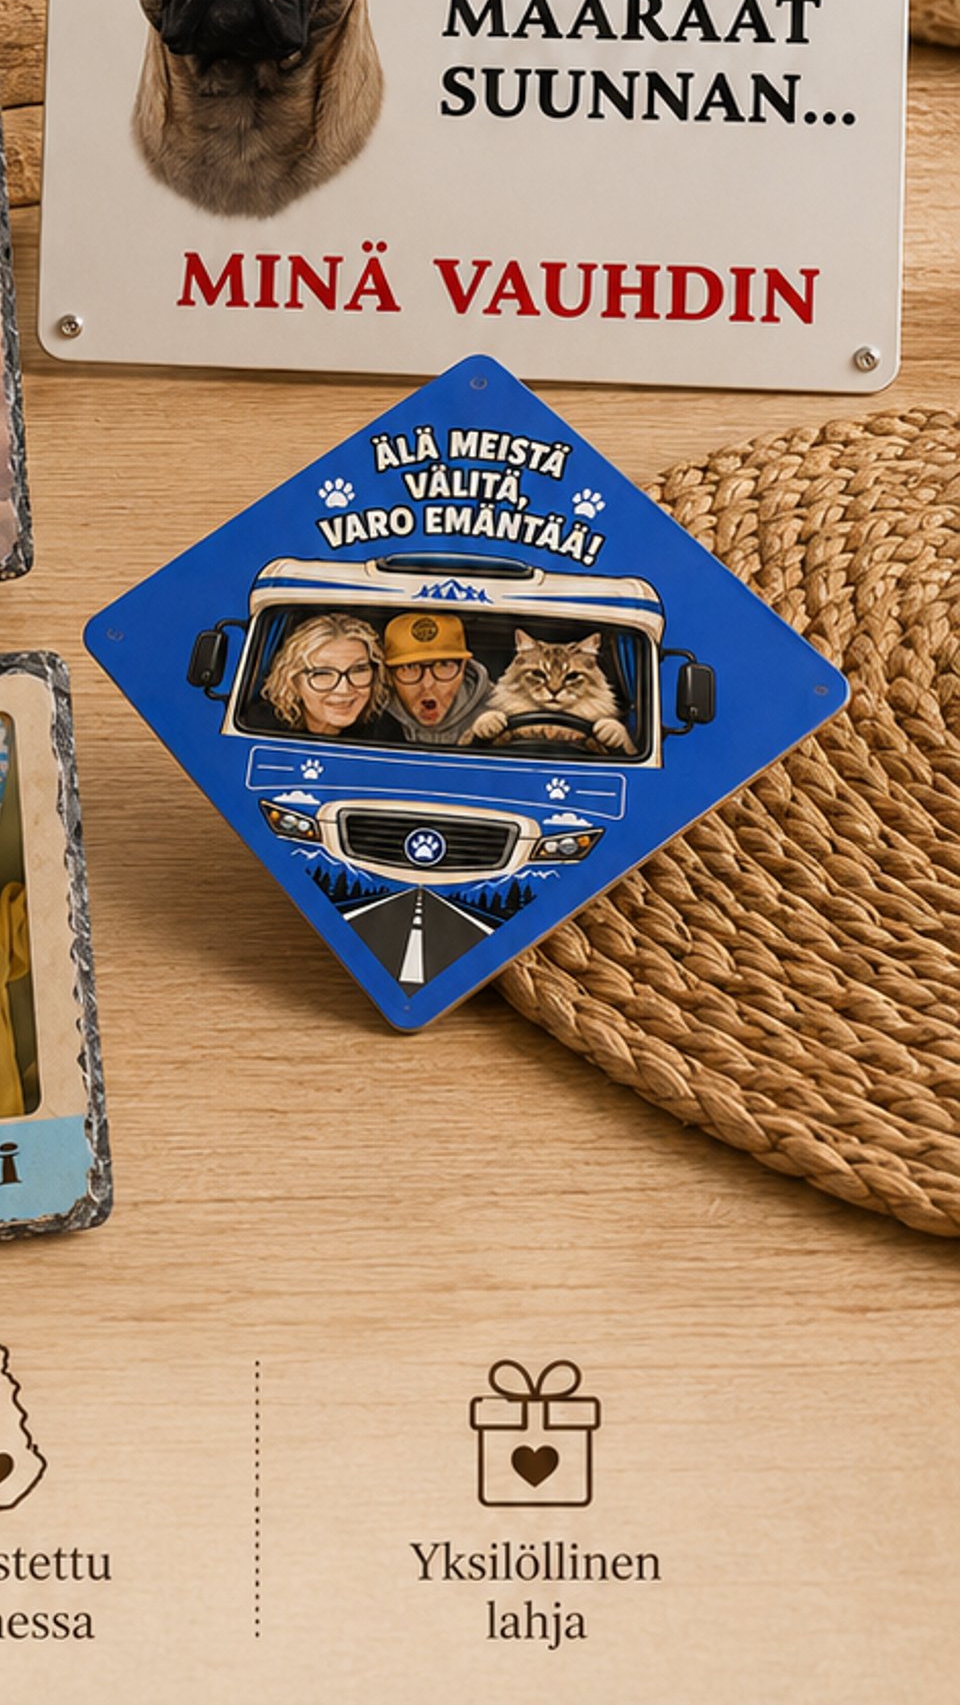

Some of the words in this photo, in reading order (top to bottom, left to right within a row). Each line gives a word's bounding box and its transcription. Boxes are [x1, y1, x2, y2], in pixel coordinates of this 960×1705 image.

[441, 67, 855, 125] SUUNNAN...
[177, 241, 401, 312] MINÄ
[433, 259, 819, 324] VAUHDIN
[371, 426, 440, 473] ÄLÄ
[448, 429, 571, 479] MEISTÄ
[404, 463, 529, 511] VÄLITÄ,
[318, 505, 415, 549] VARO
[424, 503, 605, 567] EMÄNTÄÄ!
